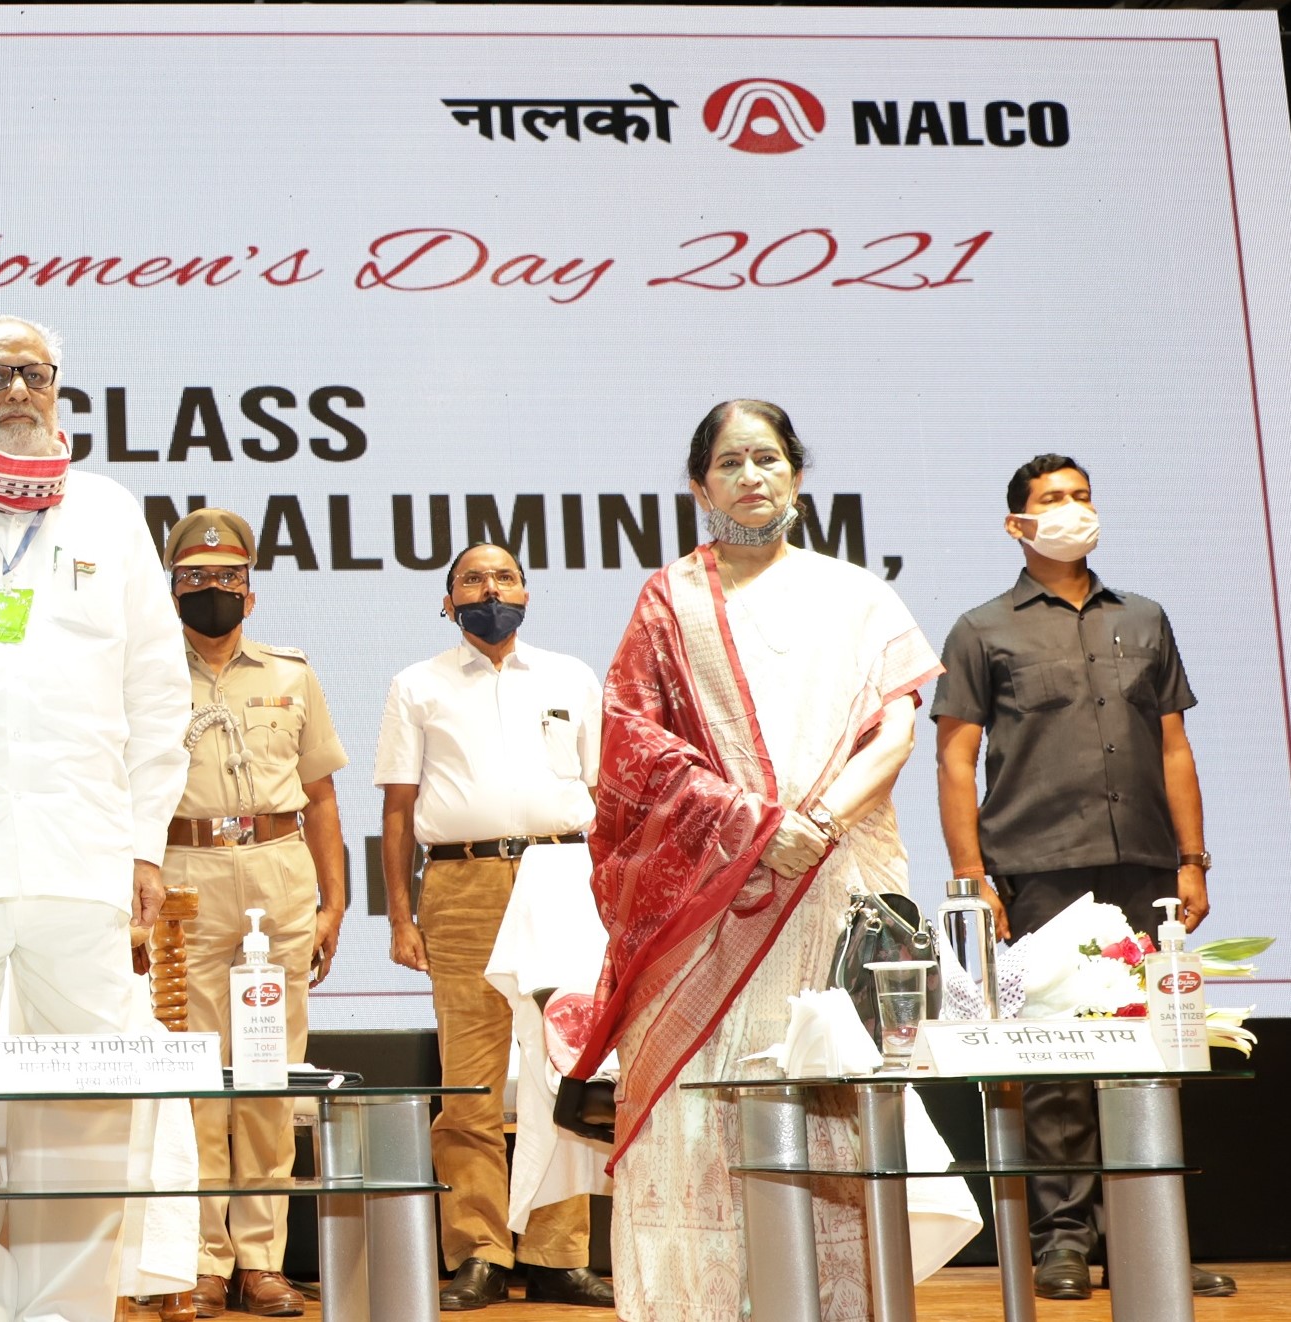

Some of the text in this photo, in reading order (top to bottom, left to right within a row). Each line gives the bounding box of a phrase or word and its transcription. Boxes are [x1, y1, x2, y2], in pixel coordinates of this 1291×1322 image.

[440, 83, 679, 143] नालको
[851, 100, 1071, 147] NALCO
[355, 228, 615, 304] Day
[647, 228, 994, 291] 2021
[254, 493, 903, 581] ALUMINIM,
[1162, 978, 1199, 986] Lifbuoy
[246, 990, 280, 999] Lifbuoy
[1, 1035, 208, 1055] प्रोफेसर गणेशी लाल
[957, 1026, 1137, 1045] डॉ. प्रतिभा राय
[254, 1042, 277, 1051] Total
[1016, 1051, 1095, 1064] मुख्य वक्ता
